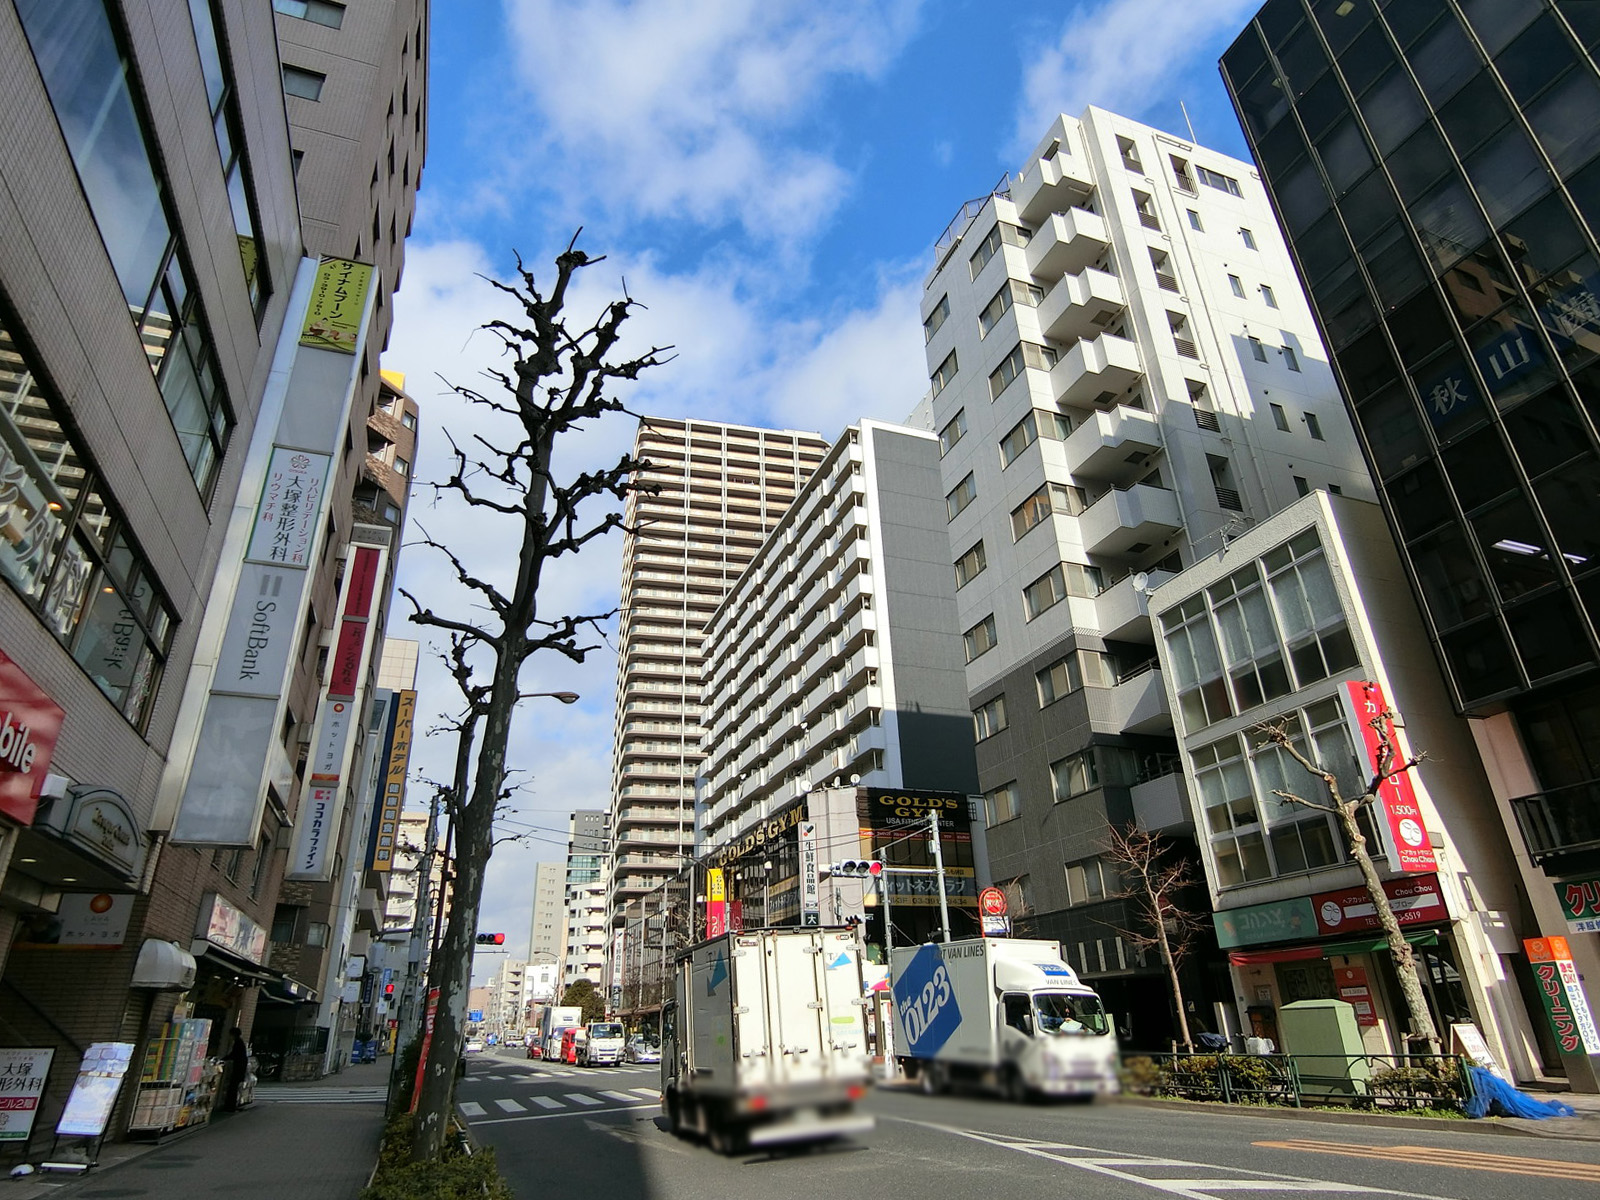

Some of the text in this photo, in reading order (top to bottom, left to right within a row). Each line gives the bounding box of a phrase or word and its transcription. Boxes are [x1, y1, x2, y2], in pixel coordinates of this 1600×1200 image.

[263, 472, 282, 522] リウマチ科
[269, 475, 305, 561] 大塚整形外科
[292, 478, 319, 563] リハビリテーション科
[240, 600, 277, 681] SoftBank
[0, 711, 36, 774] bile
[324, 721, 341, 771] ホットヨガ
[388, 697, 414, 775] スーパーホテル
[879, 795, 958, 809] GOLD'S
[305, 802, 325, 870] ココカラファイン
[720, 804, 804, 867] GOLD'S GYM
[1395, 887, 1413, 896] Chou
[1414, 884, 1433, 894] Chou
[65, 930, 121, 939] ホットヨガ
[948, 946, 963, 959] VAN
[963, 944, 984, 958] LINES
[904, 965, 950, 1046] 0123
[1537, 964, 1580, 1052] クリーニング
[2, 1062, 34, 1077] 大塚
